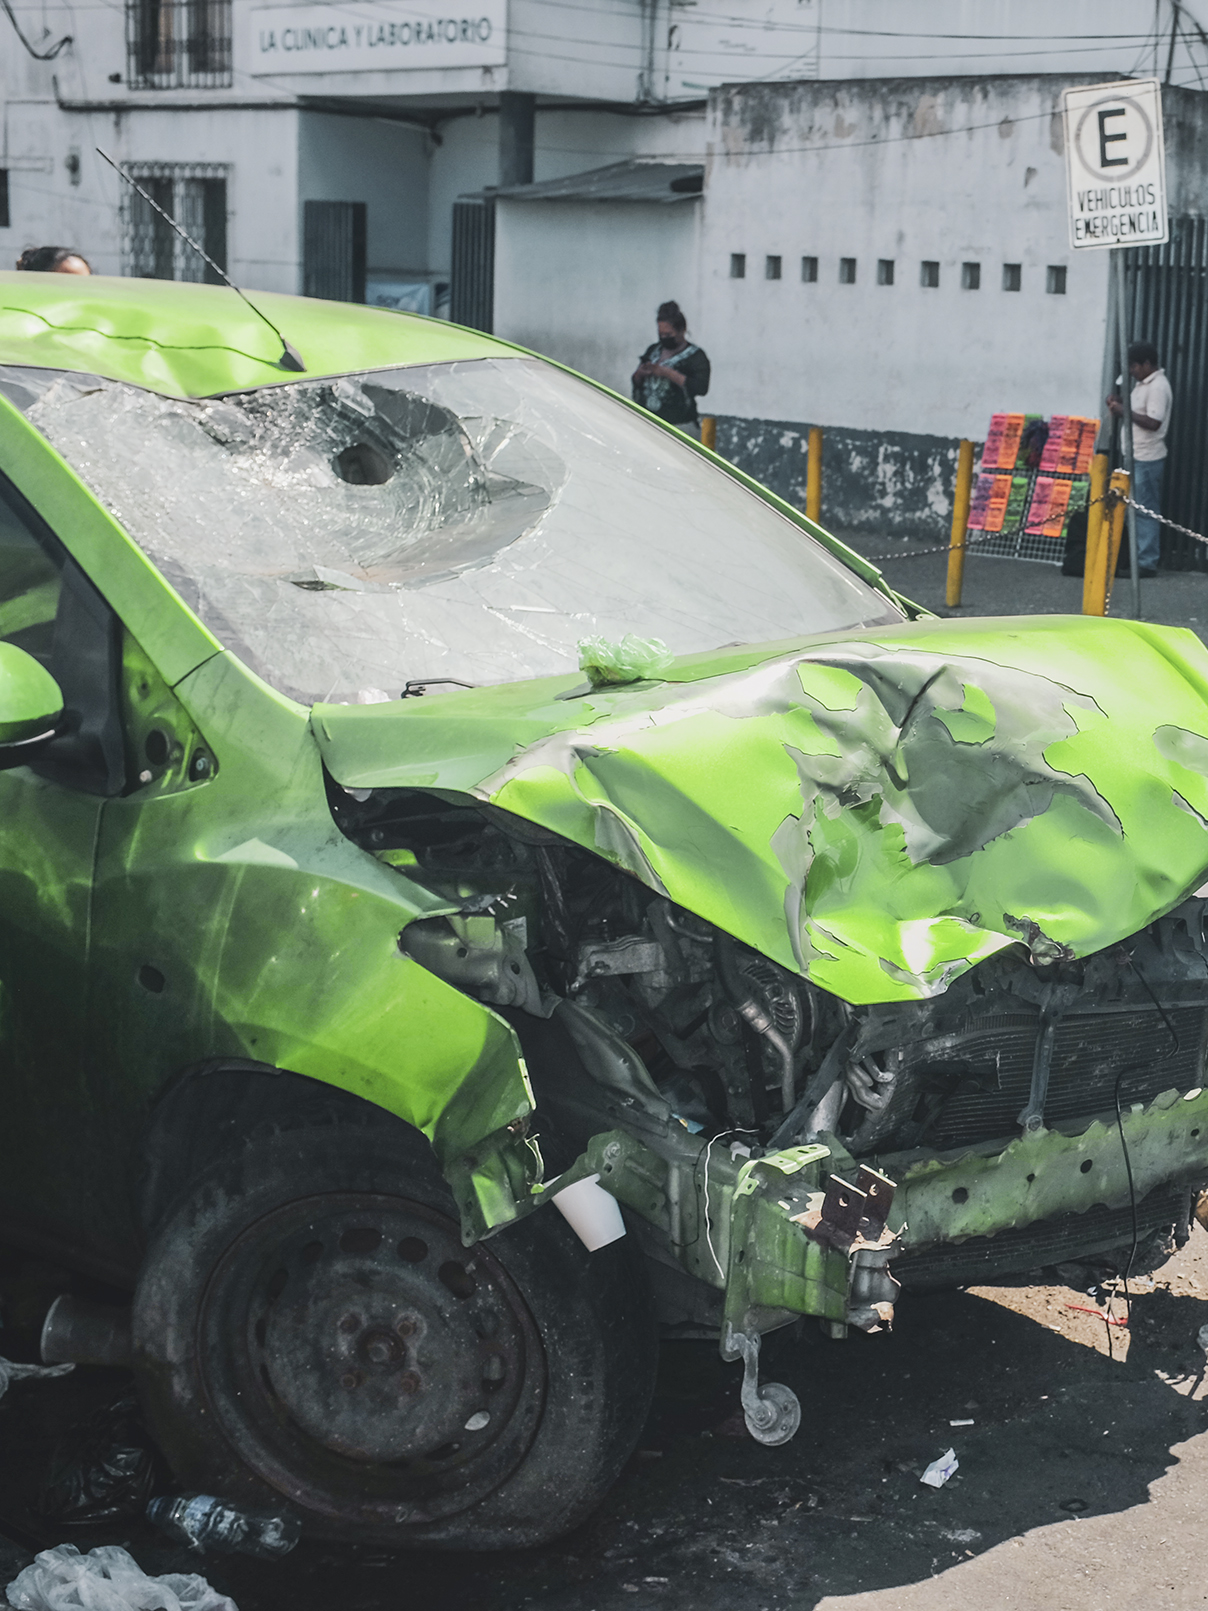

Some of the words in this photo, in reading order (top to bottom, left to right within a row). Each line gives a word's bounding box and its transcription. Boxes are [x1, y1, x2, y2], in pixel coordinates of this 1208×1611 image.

[259, 30, 277, 52] LA
[353, 25, 366, 48] Y
[367, 17, 493, 48] LABORATORIO
[1098, 108, 1129, 168] E
[1077, 184, 1156, 213] VEHICULOS
[1075, 210, 1159, 240] EMERGENCIA
